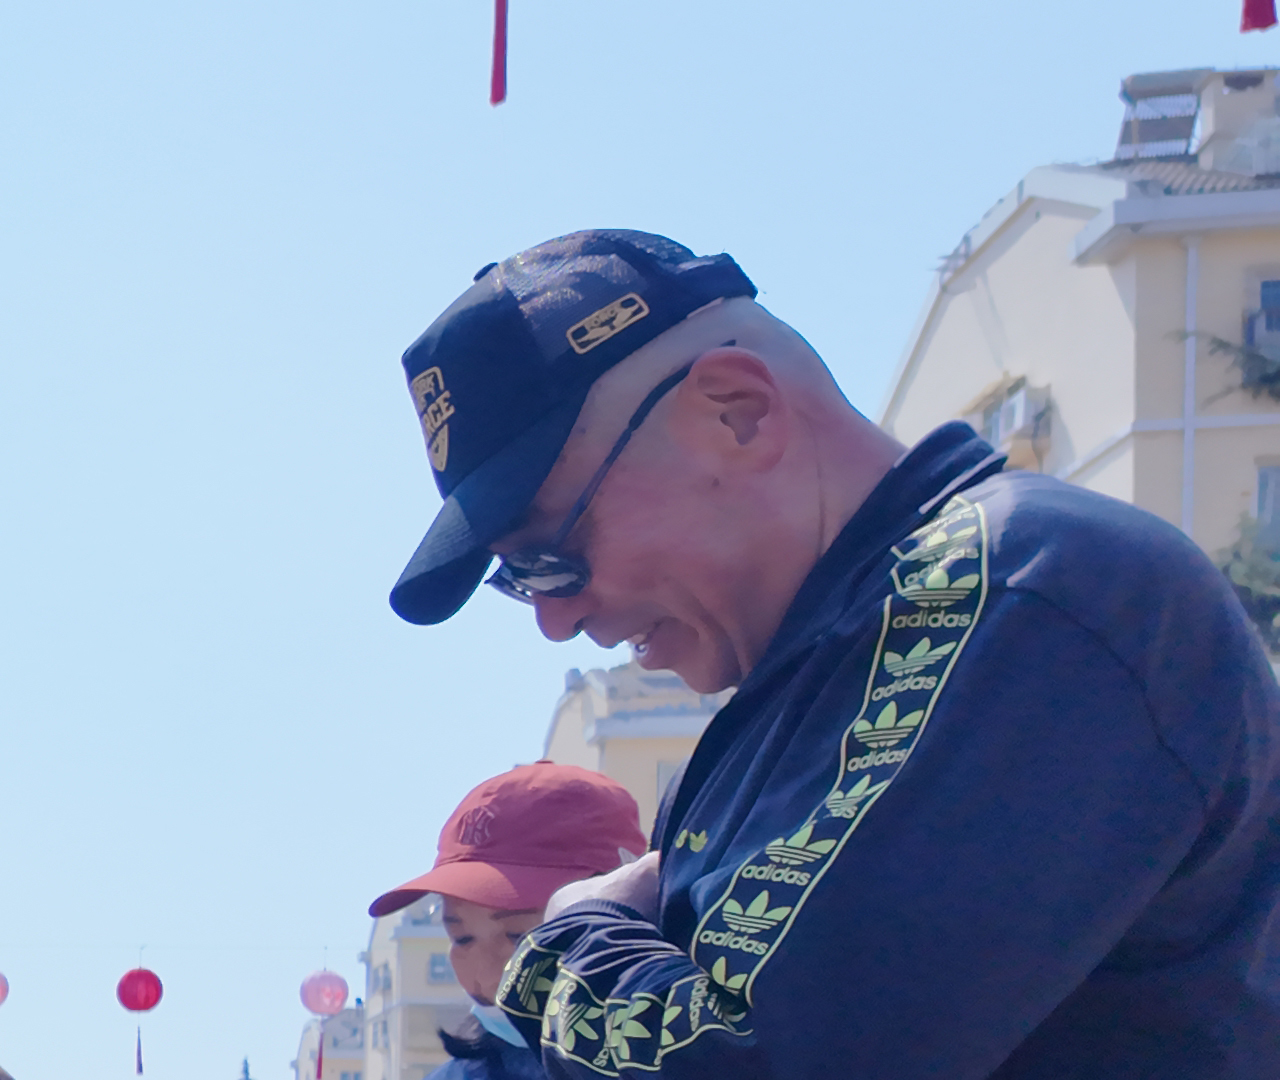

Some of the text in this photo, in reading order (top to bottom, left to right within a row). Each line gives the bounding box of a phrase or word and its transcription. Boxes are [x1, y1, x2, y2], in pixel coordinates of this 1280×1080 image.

[892, 609, 972, 629] adidas
[871, 675, 939, 702] adidas
[847, 748, 910, 772] adidas
[741, 864, 811, 887] adidas
[699, 930, 769, 956] adidas
